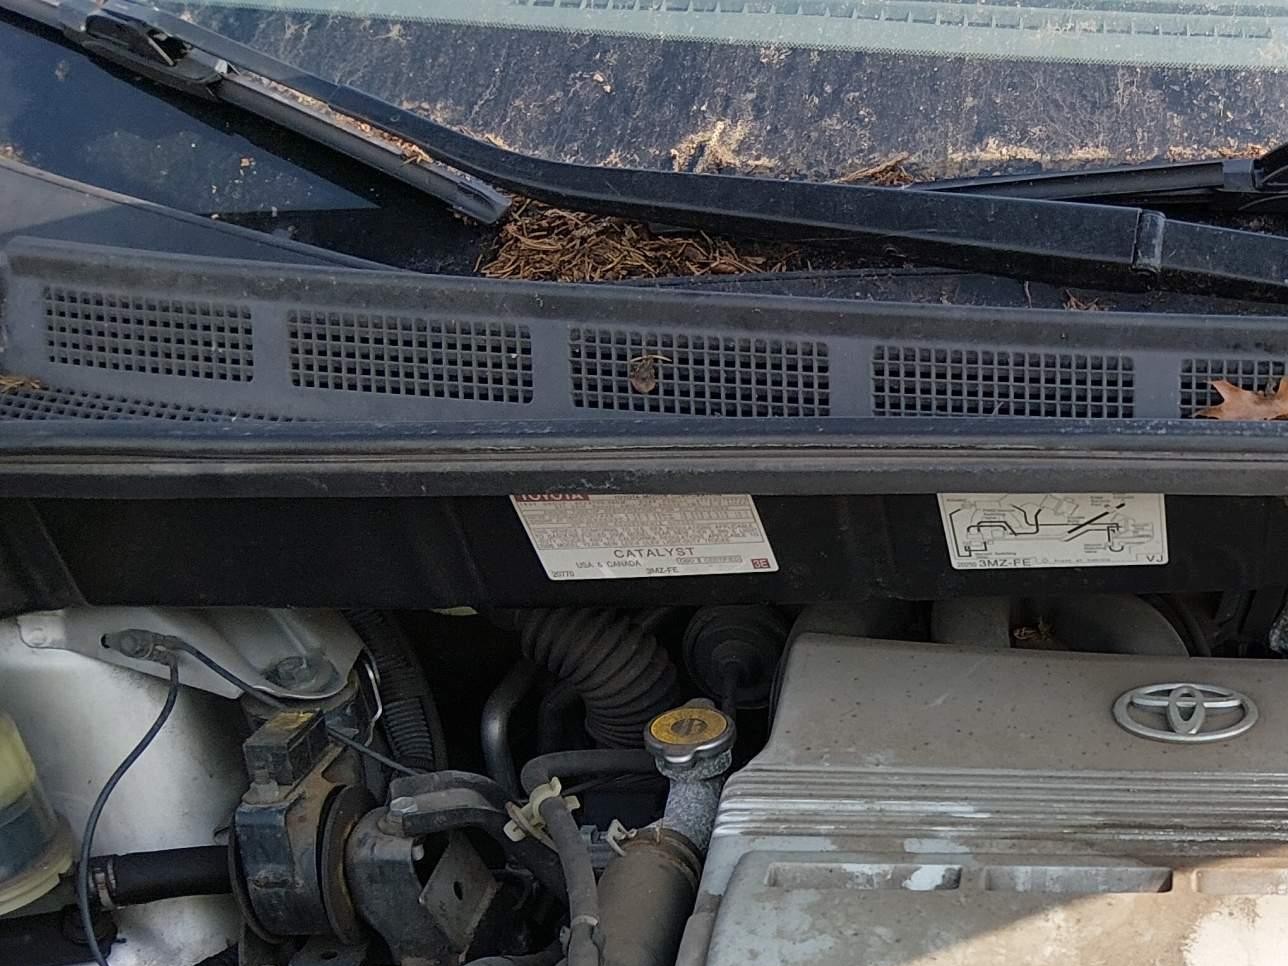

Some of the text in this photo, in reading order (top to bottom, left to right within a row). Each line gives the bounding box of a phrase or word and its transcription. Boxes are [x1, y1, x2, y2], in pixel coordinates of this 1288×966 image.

[614, 546, 695, 559] CATALYST
[606, 560, 642, 568] CANADA
[753, 560, 768, 568] 3E
[979, 559, 1032, 567] 3MZ-FE
